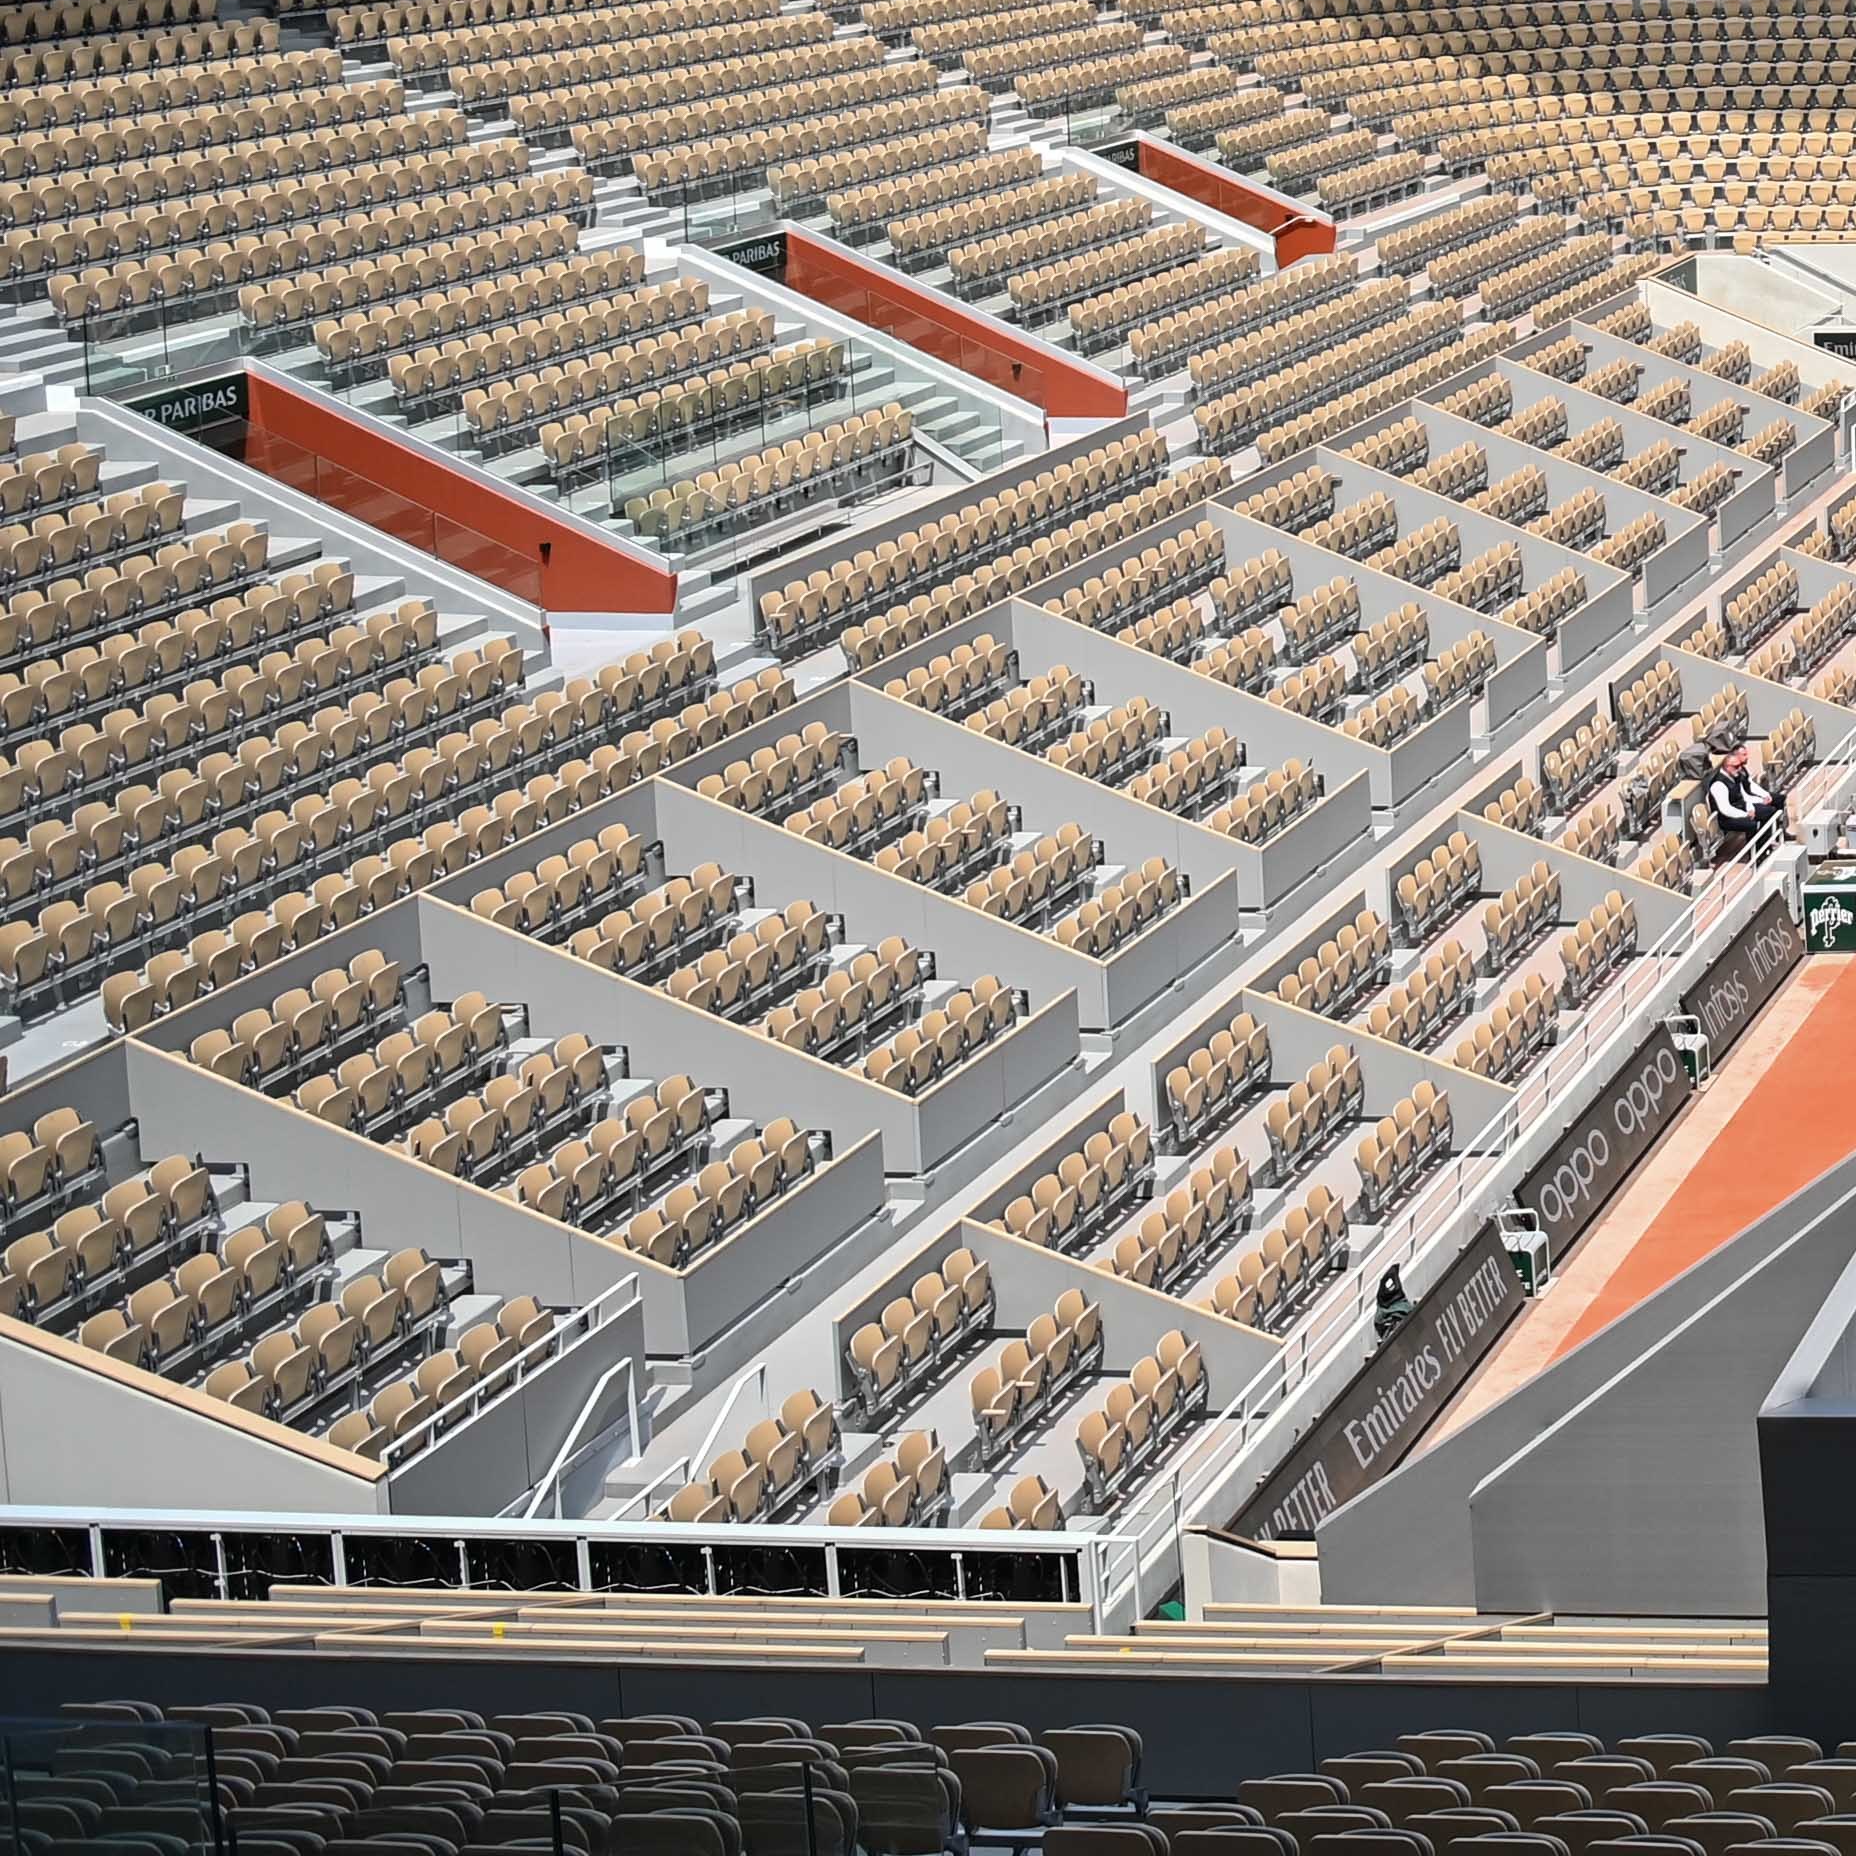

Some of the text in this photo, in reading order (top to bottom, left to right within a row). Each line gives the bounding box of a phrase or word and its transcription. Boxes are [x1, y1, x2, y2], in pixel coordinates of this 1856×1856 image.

[733, 241, 779, 265] PARIBAS
[161, 385, 237, 424] PARIBAS
[1748, 916, 1793, 983] Infosys
[1810, 907, 1854, 936] perrier
[1698, 969, 1750, 1039] Infosys
[1614, 1048, 1677, 1135] oppo
[1540, 1129, 1609, 1222] oppo
[1343, 1255, 1509, 1471] Emirates FLY BETTER
